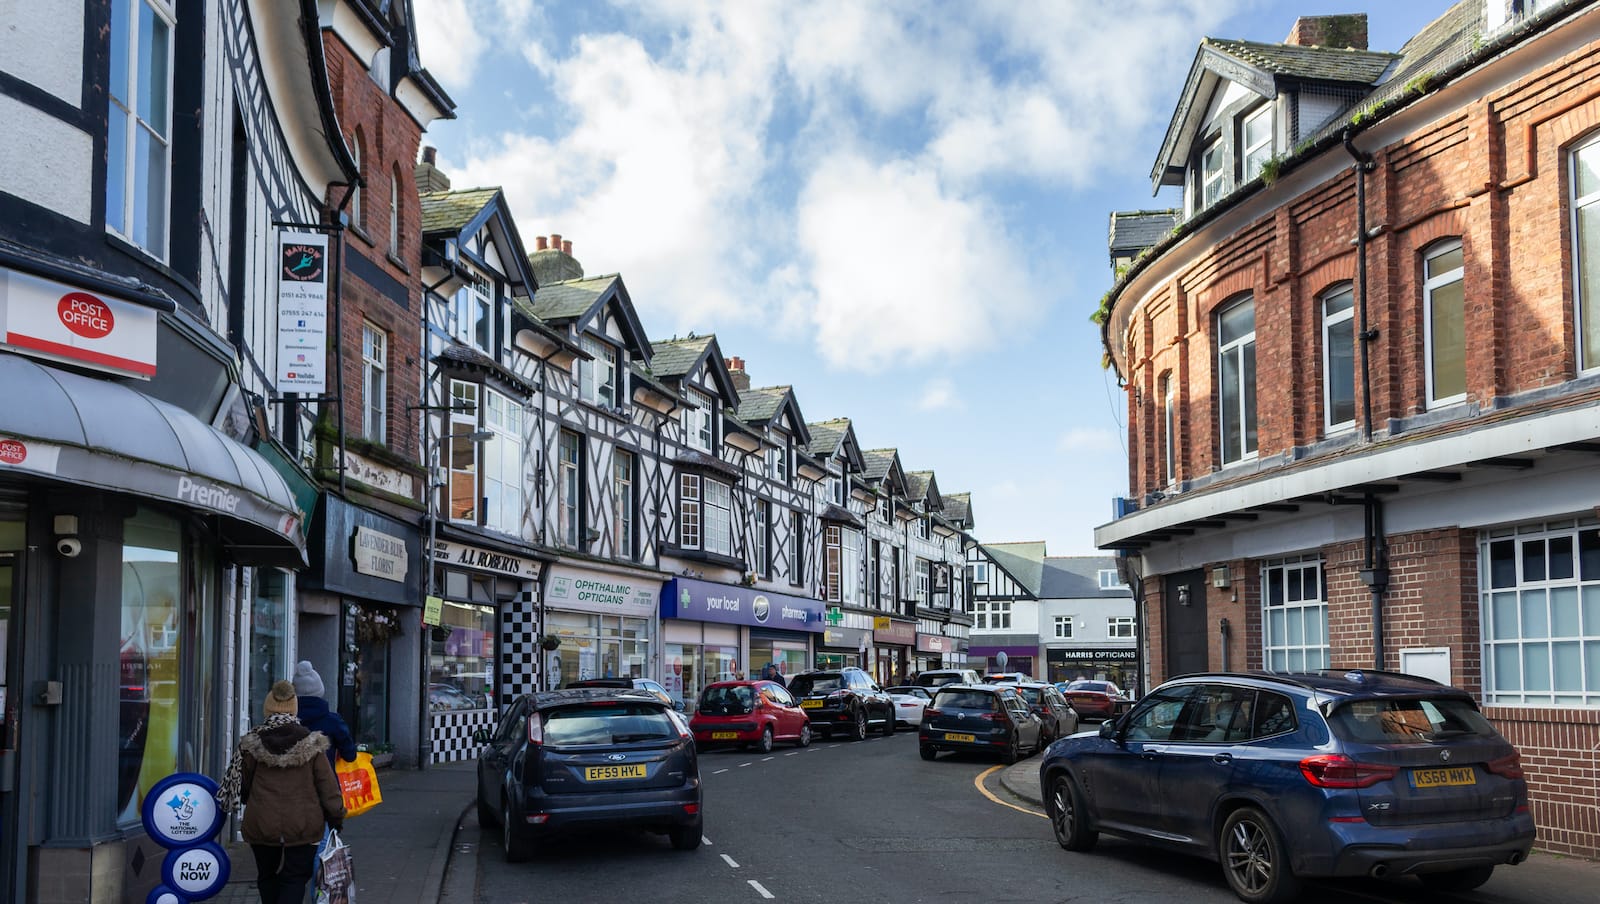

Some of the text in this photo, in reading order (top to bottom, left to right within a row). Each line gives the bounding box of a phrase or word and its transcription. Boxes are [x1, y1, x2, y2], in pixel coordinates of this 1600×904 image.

[71, 299, 104, 317] POST
[63, 310, 108, 331] OFFICE
[2, 443, 21, 452] POST
[177, 476, 240, 512] Premier
[360, 531, 388, 554] LAVENDER
[371, 556, 394, 576] FLORIST
[477, 551, 520, 573] ROBERTS
[575, 579, 631, 595] OPHTHALMIC
[578, 591, 624, 605] OPTICIANS
[706, 597, 723, 611] your
[723, 596, 740, 611] local
[782, 604, 807, 622] pharmacy
[1065, 651, 1136, 659] HARRIS OPTICIANS
[590, 765, 642, 779] EF59 HYL
[1416, 769, 1447, 784] KS68
[181, 862, 212, 871] PLAY
[180, 871, 211, 881] NOW
